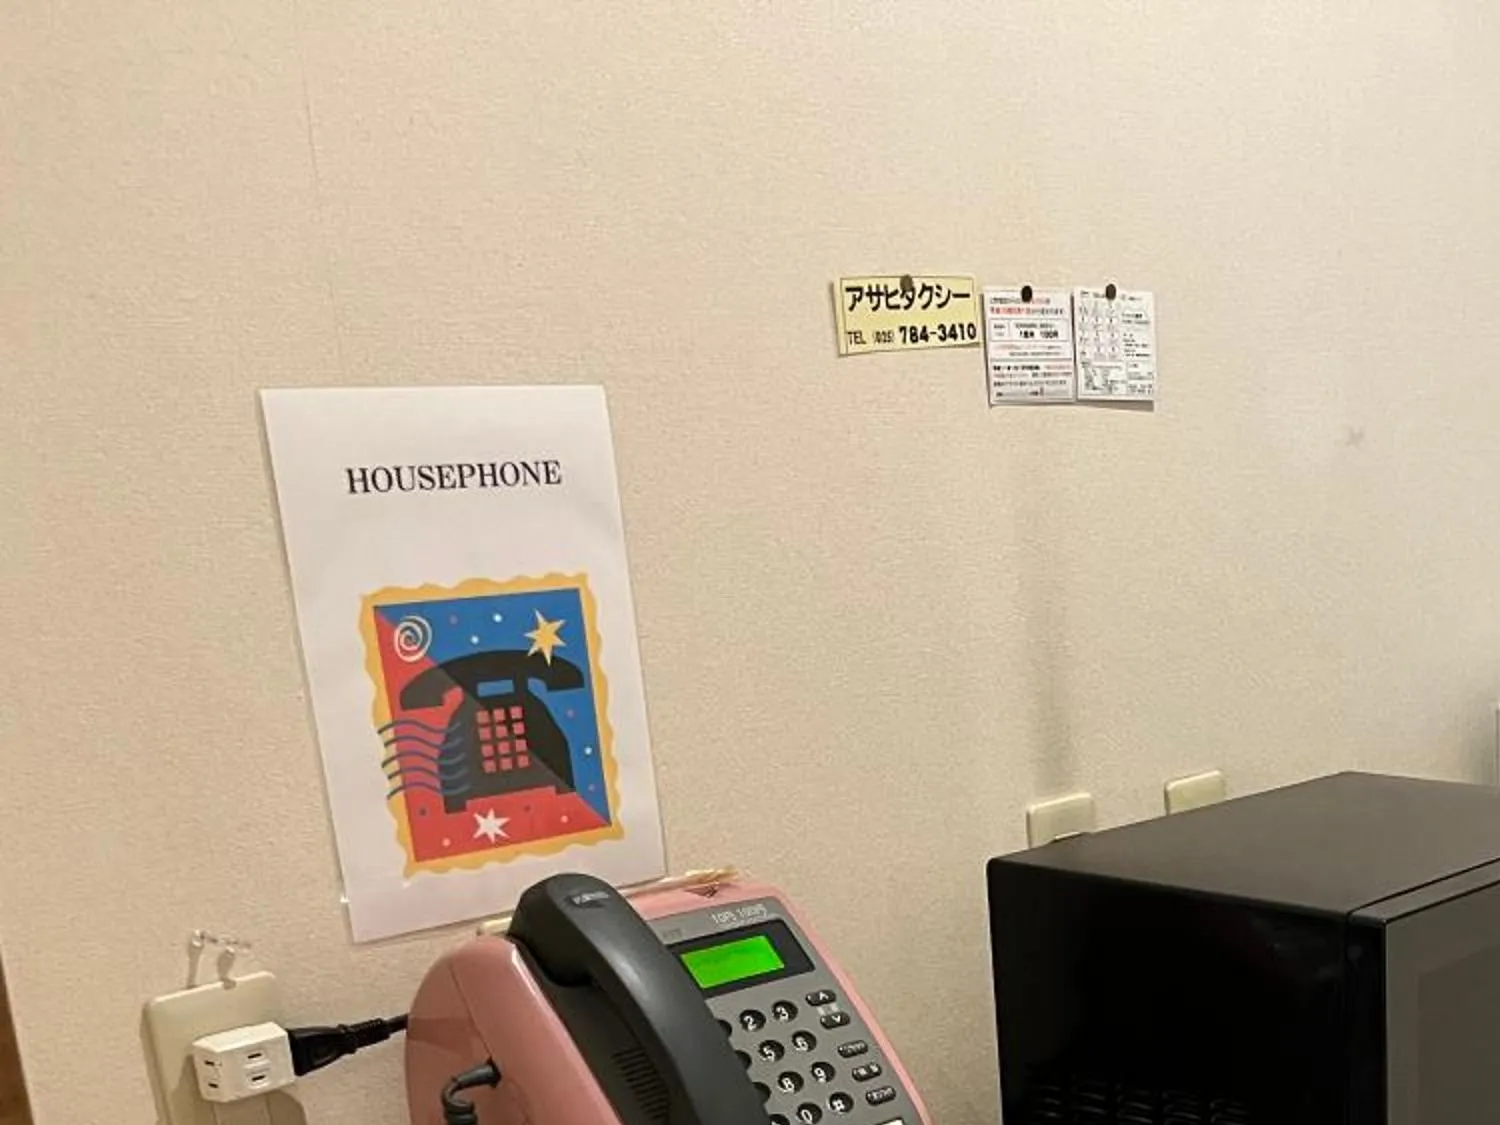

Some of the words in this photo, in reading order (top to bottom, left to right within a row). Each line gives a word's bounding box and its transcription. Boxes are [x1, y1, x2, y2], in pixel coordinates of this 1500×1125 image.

[845, 283, 971, 312] アサヒタクシー
[847, 331, 867, 345] TEL
[899, 323, 977, 344] 784-3410
[346, 459, 562, 494] HOUSEPHONE
